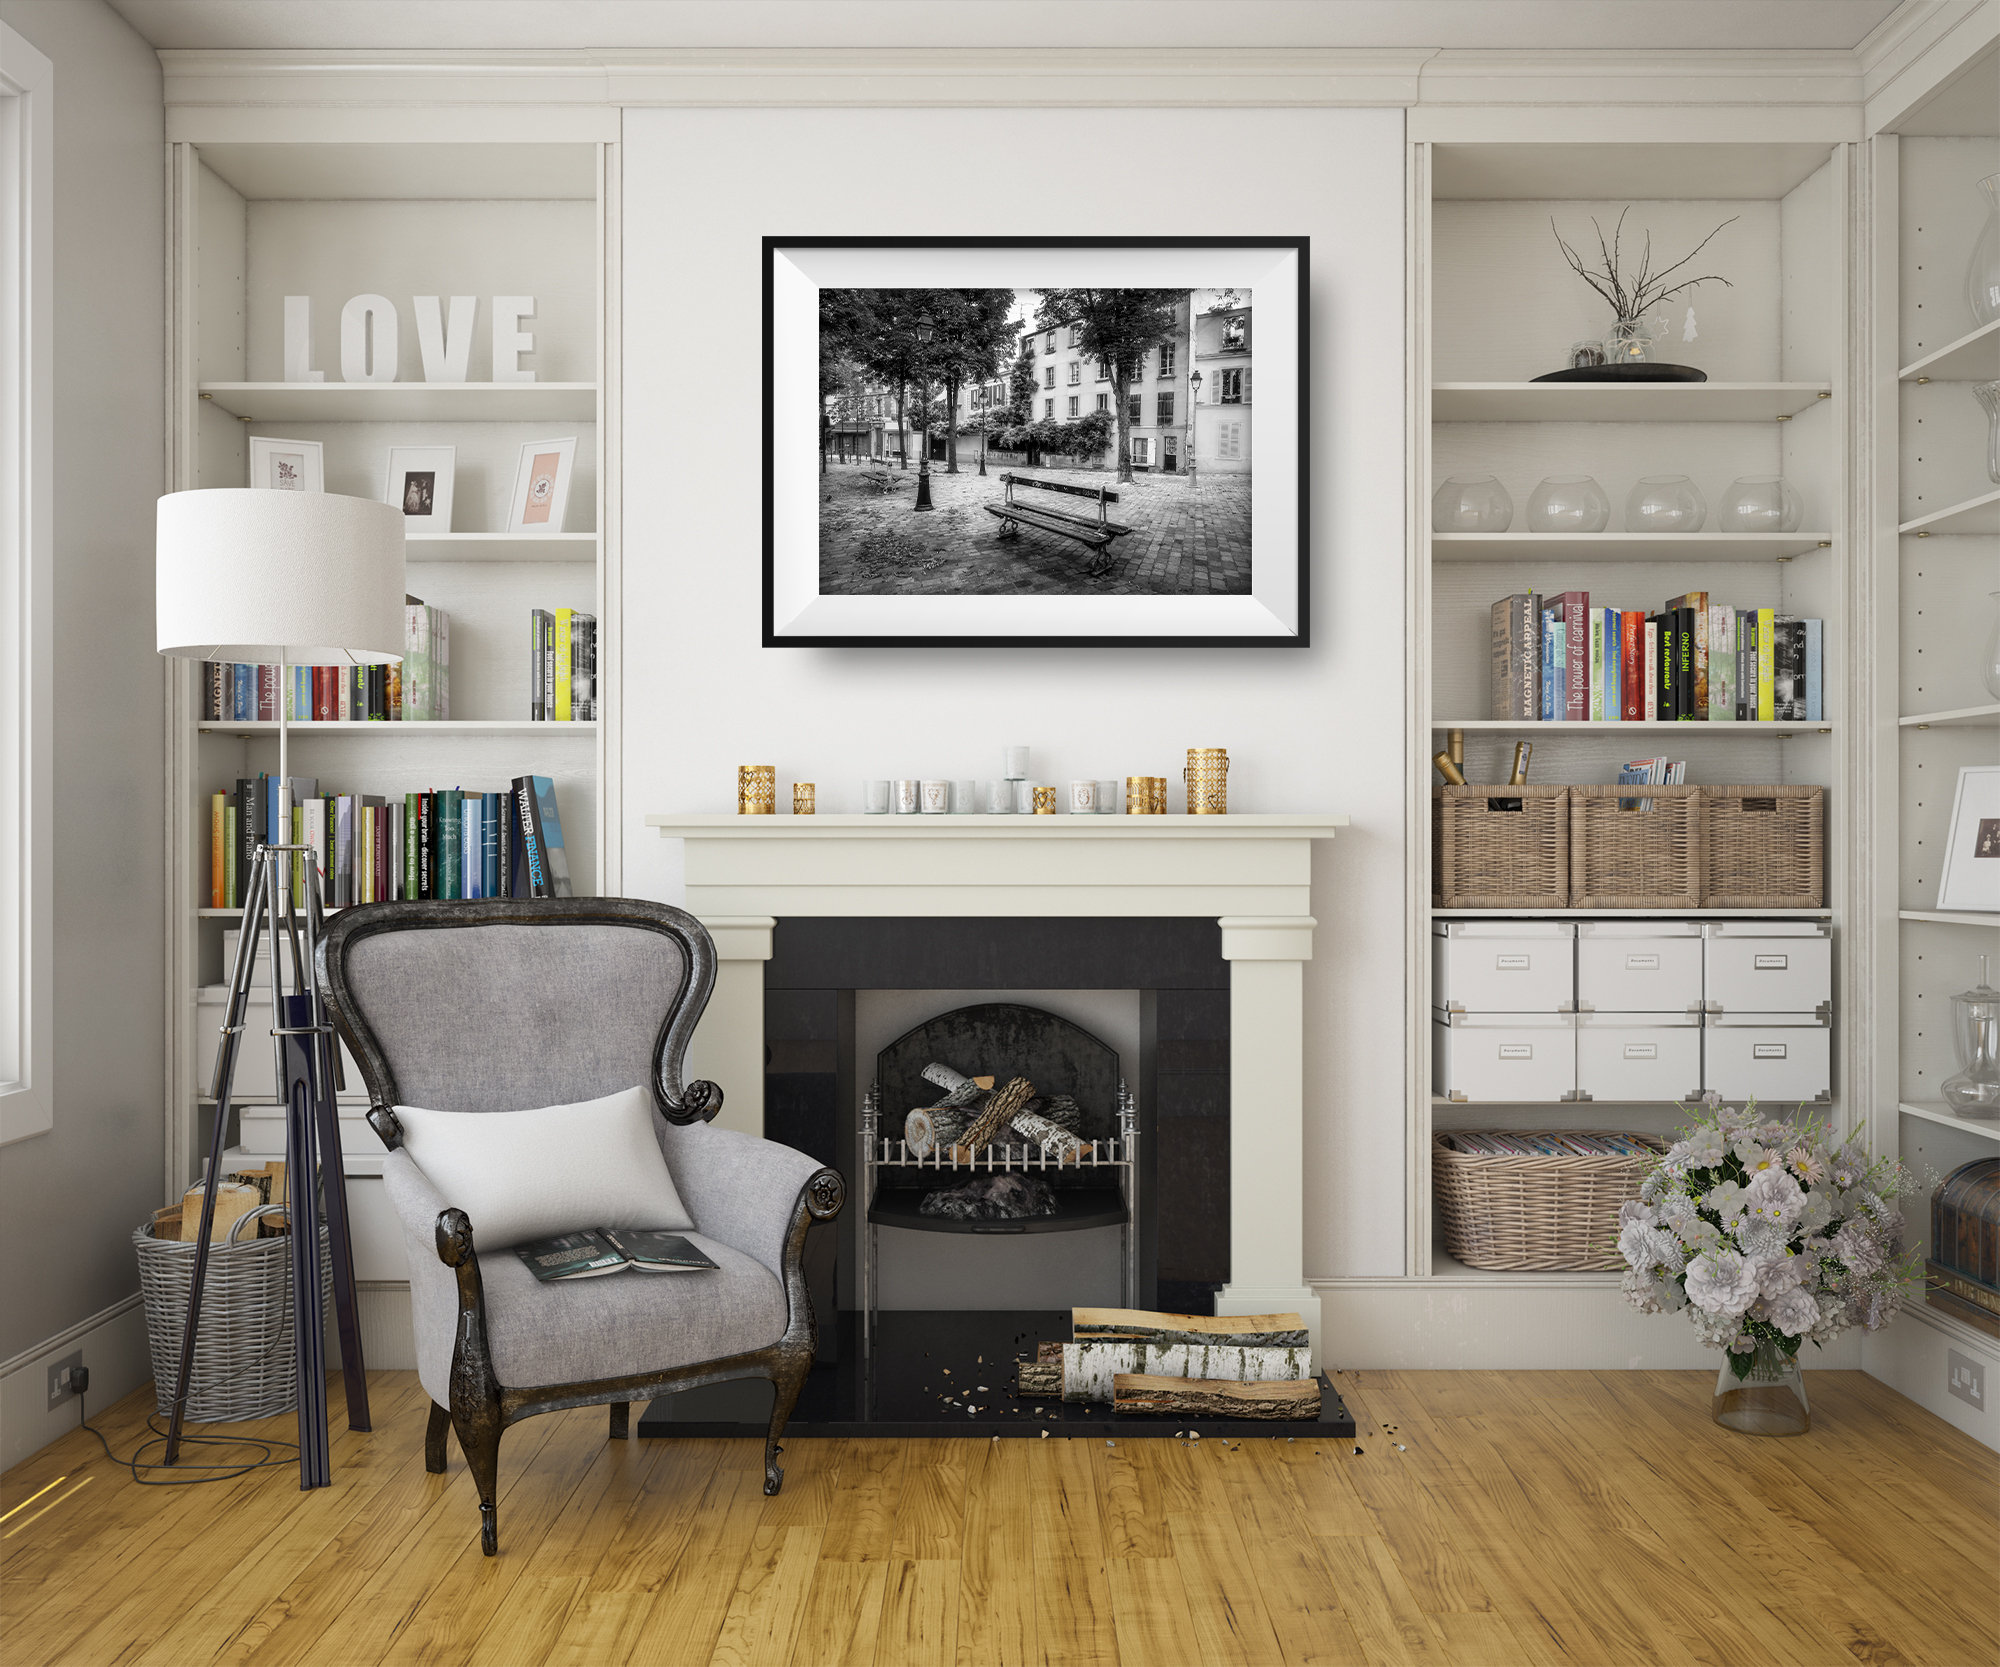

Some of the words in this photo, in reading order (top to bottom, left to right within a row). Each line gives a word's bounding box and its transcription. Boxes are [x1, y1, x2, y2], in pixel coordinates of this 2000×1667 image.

[284, 293, 537, 383] LOVE
[1524, 599, 1533, 650] APPEAL
[1566, 603, 1584, 642] carnival
[1629, 624, 1637, 646] Perfect
[1664, 631, 1672, 647] Best
[546, 651, 554, 660] Feel
[1566, 643, 1584, 656] of
[1628, 647, 1637, 665] Story
[1681, 632, 1689, 672] INFERNO
[264, 664, 281, 689] powe
[1571, 659, 1589, 690] power
[1664, 649, 1672, 690] restaurants
[213, 662, 222, 717] MAGNET
[545, 683, 553, 693] your
[1524, 651, 1533, 717] MAGNETIC
[260, 692, 276, 711] The
[546, 694, 554, 708] house
[1566, 692, 1584, 711] The
[245, 797, 255, 815] Man
[421, 798, 429, 815] Inside
[517, 787, 535, 836] WALTER
[245, 817, 255, 834] and
[420, 815, 428, 828] your
[421, 828, 429, 843] brain
[245, 836, 254, 860] Piano
[408, 857, 415, 865] to
[421, 847, 429, 870] discover
[525, 835, 545, 887] FINANCE
[421, 871, 429, 891] secrets
